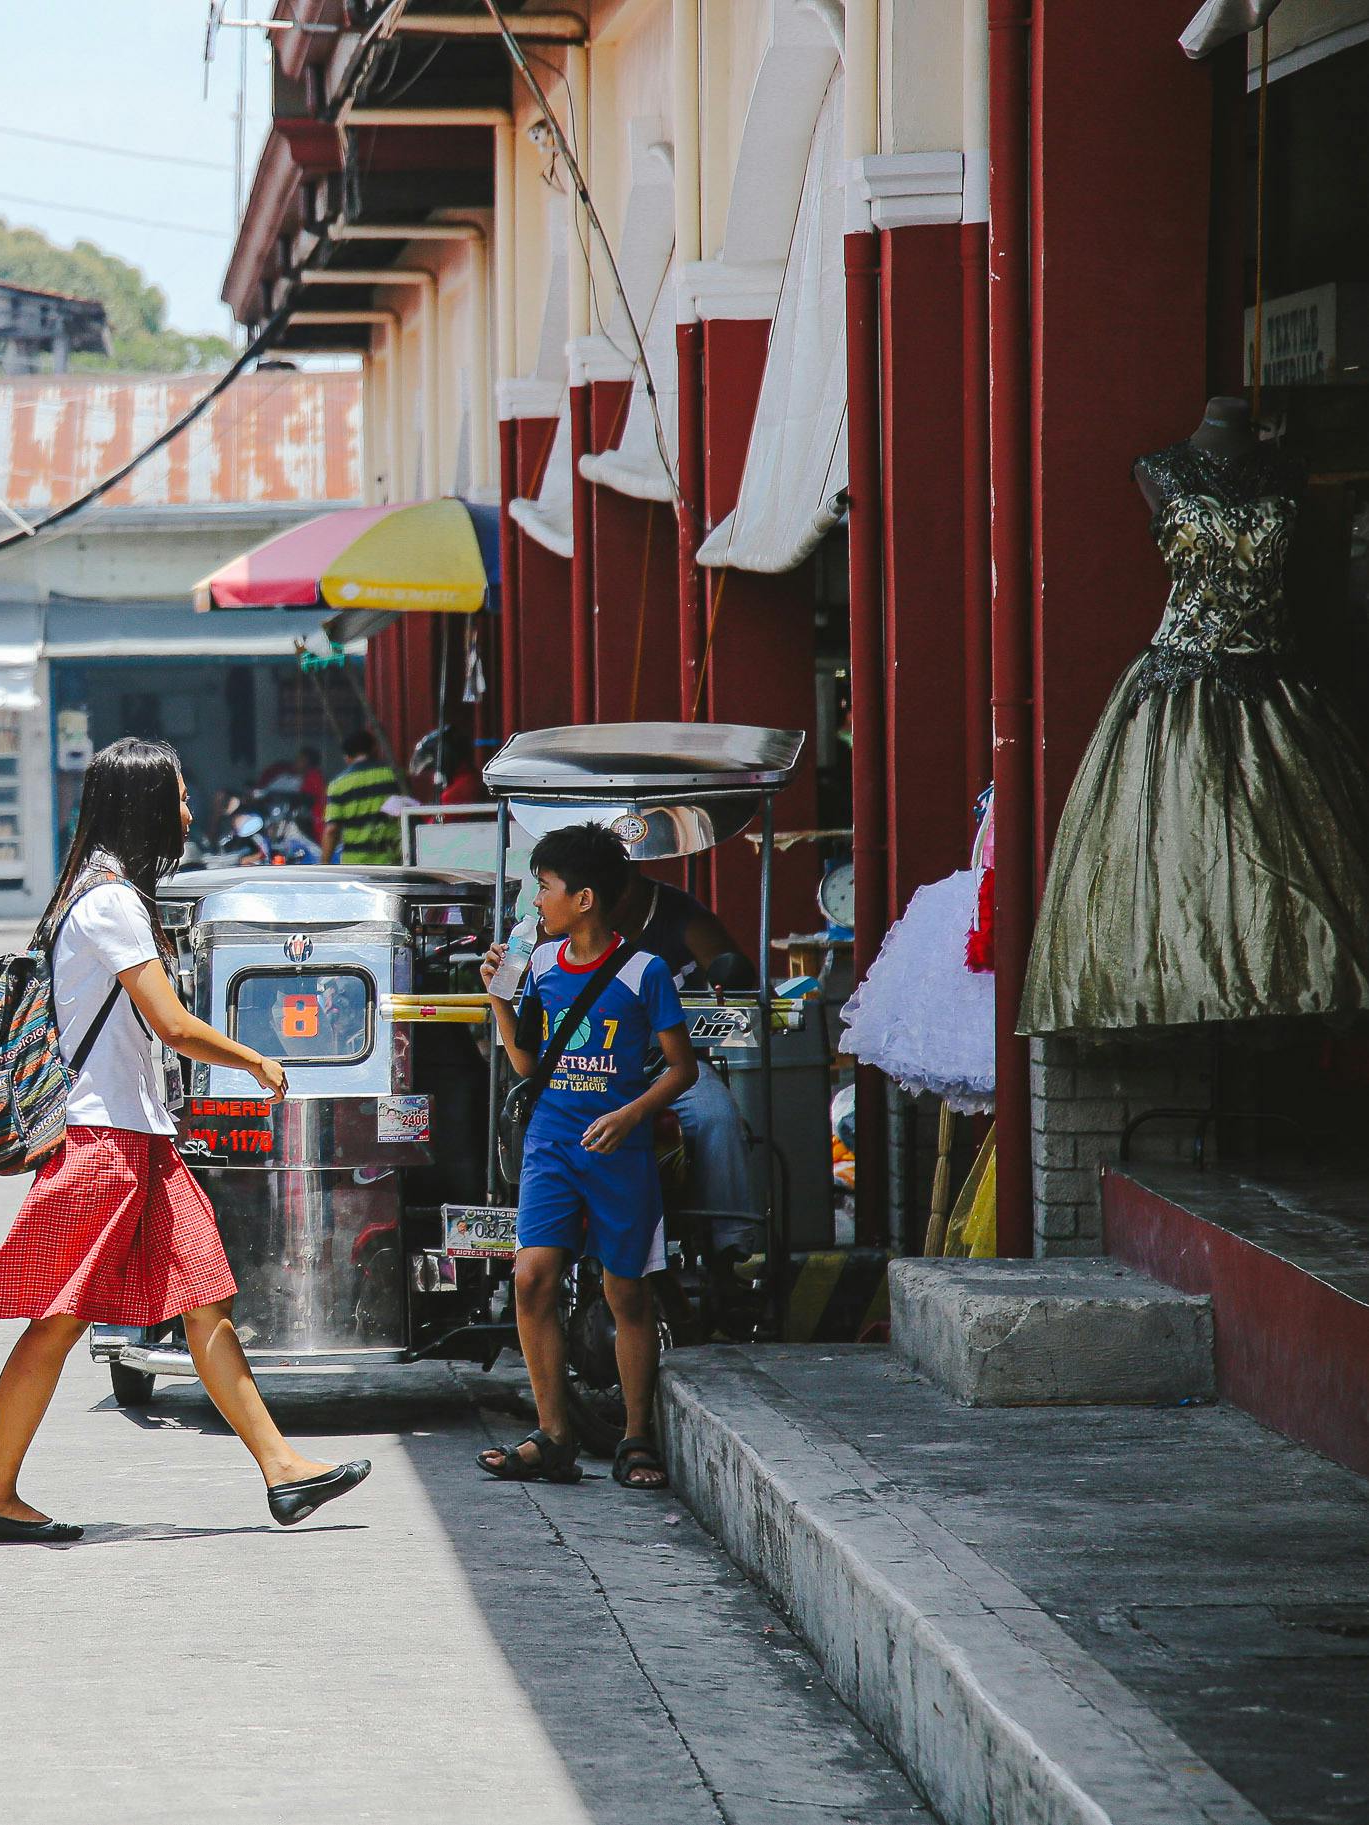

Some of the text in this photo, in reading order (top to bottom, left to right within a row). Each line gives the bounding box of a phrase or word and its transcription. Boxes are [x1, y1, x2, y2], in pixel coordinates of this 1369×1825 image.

[281, 994, 319, 1038] 8
[602, 1019, 619, 1050] 7
[570, 1080, 607, 1092] LEAGUE
[191, 1099, 271, 1118] LEMERY
[402, 1115, 428, 1126] 2406
[452, 1249, 485, 1257] TRICYCLE
[485, 1250, 509, 1258] PERMIT
